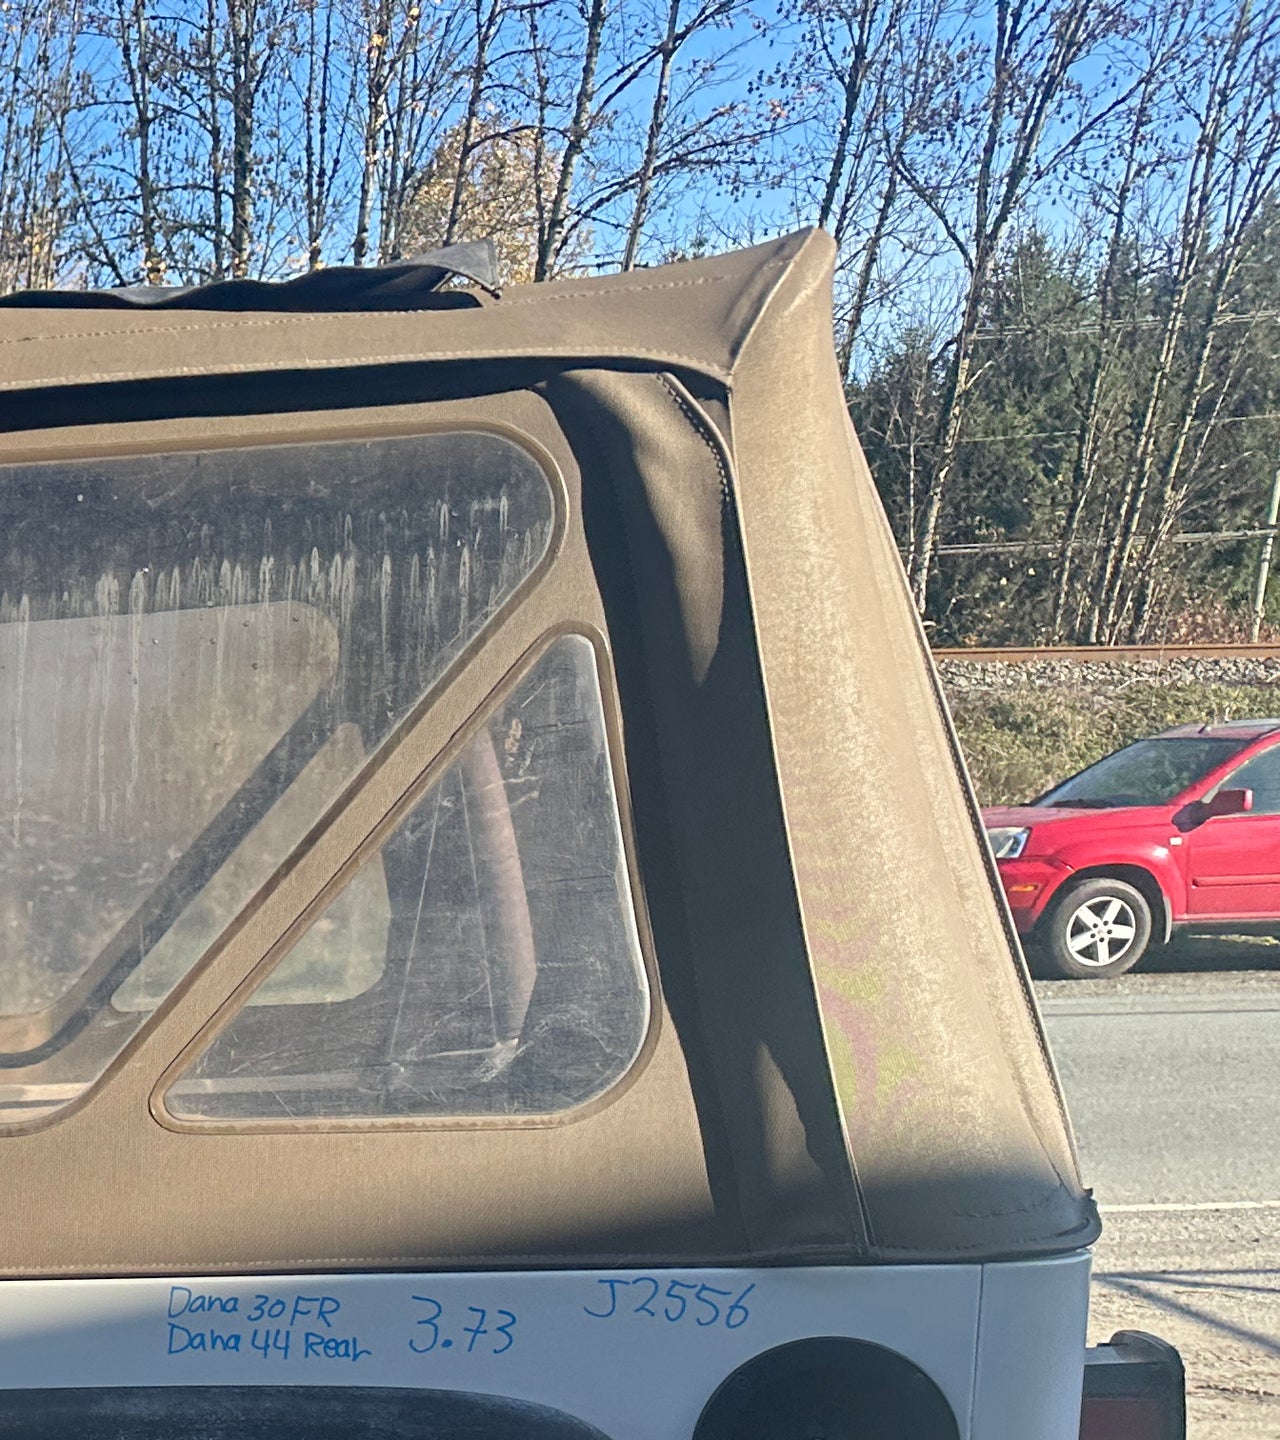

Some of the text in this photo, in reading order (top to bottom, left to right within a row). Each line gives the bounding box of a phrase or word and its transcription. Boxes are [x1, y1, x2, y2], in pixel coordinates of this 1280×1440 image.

[167, 1286, 239, 1319] Dana
[408, 1294, 517, 1354] 3.73
[584, 1276, 757, 1329] J2556
[167, 1321, 373, 1362] Dana 44 Rear
